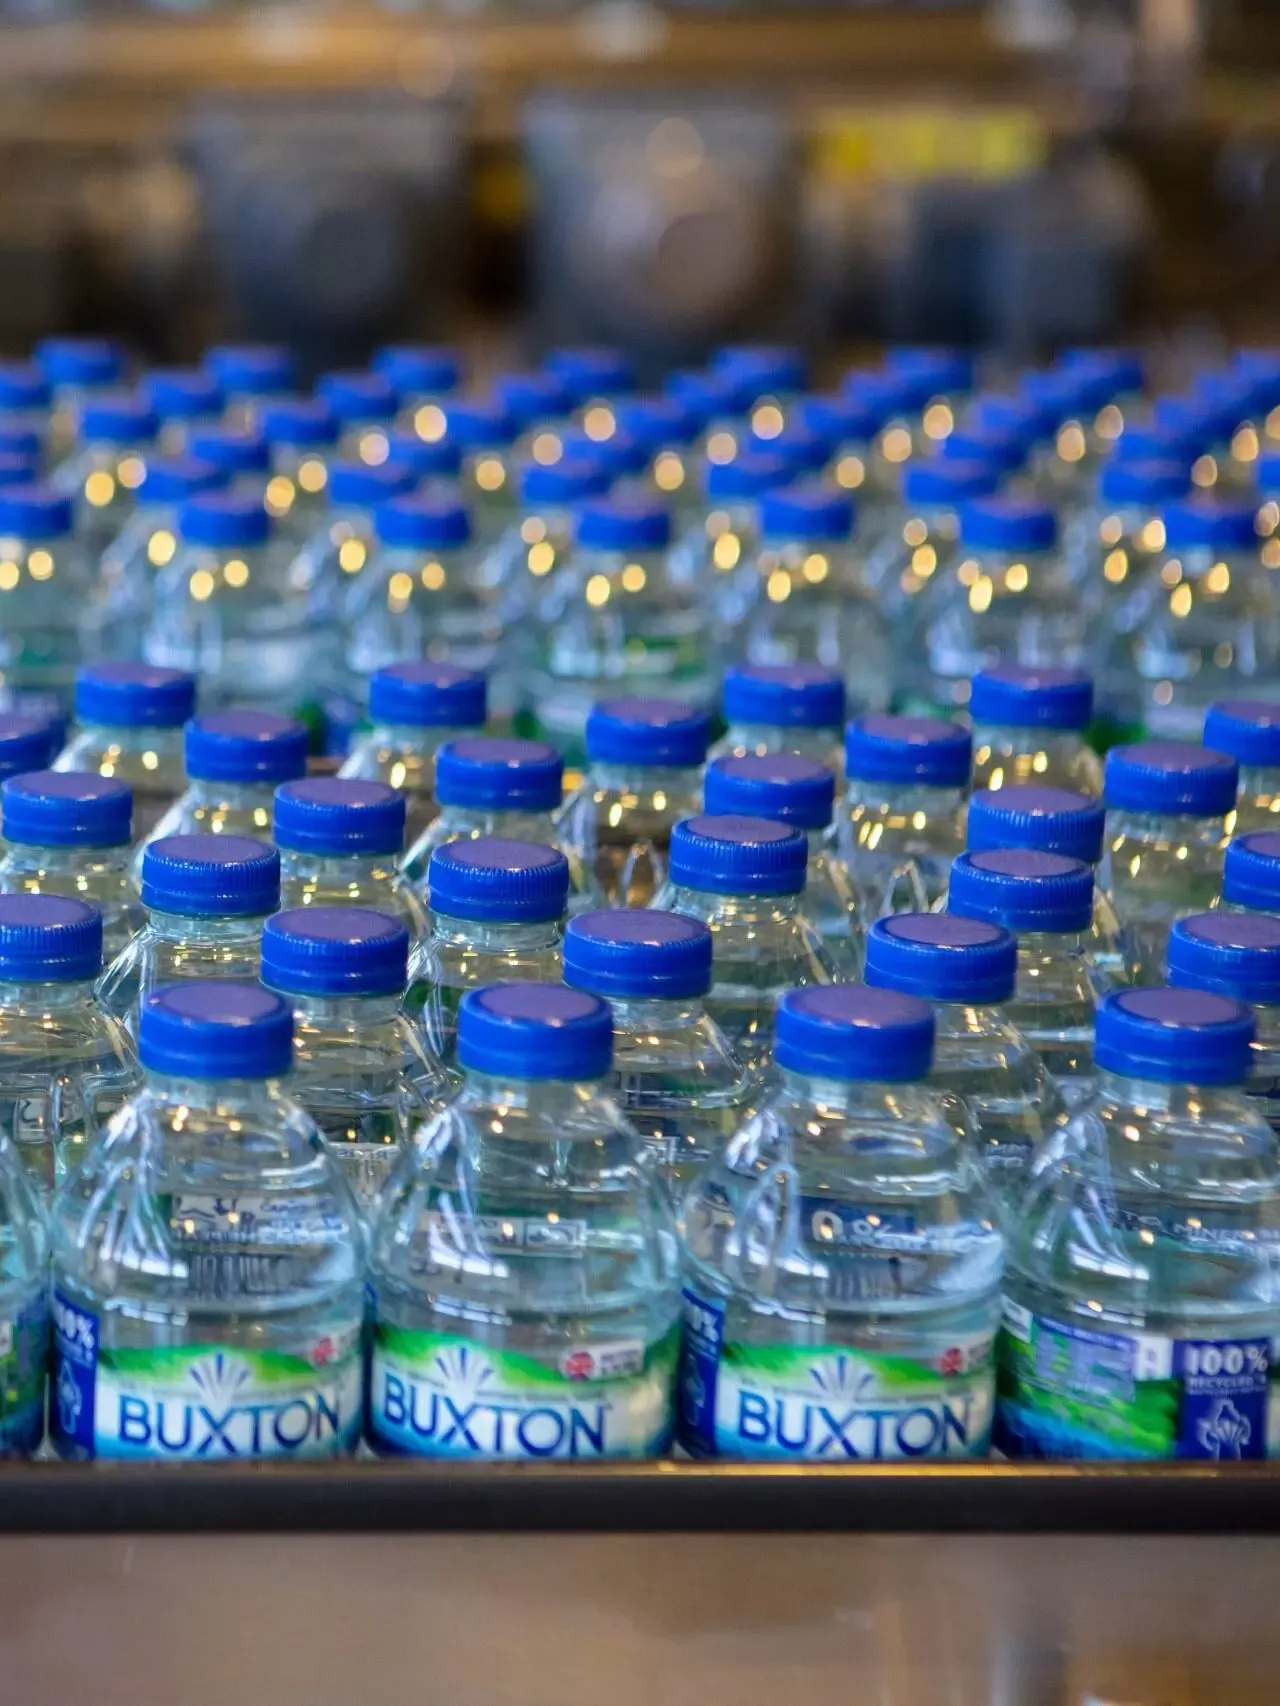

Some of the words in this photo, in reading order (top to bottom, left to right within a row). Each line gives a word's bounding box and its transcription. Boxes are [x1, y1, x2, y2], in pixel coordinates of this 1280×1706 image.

[1184, 1345, 1268, 1376] 100%
[119, 1390, 341, 1457] BUXTON
[384, 1372, 604, 1457] BUXTON
[738, 1390, 972, 1457] BUXTON
